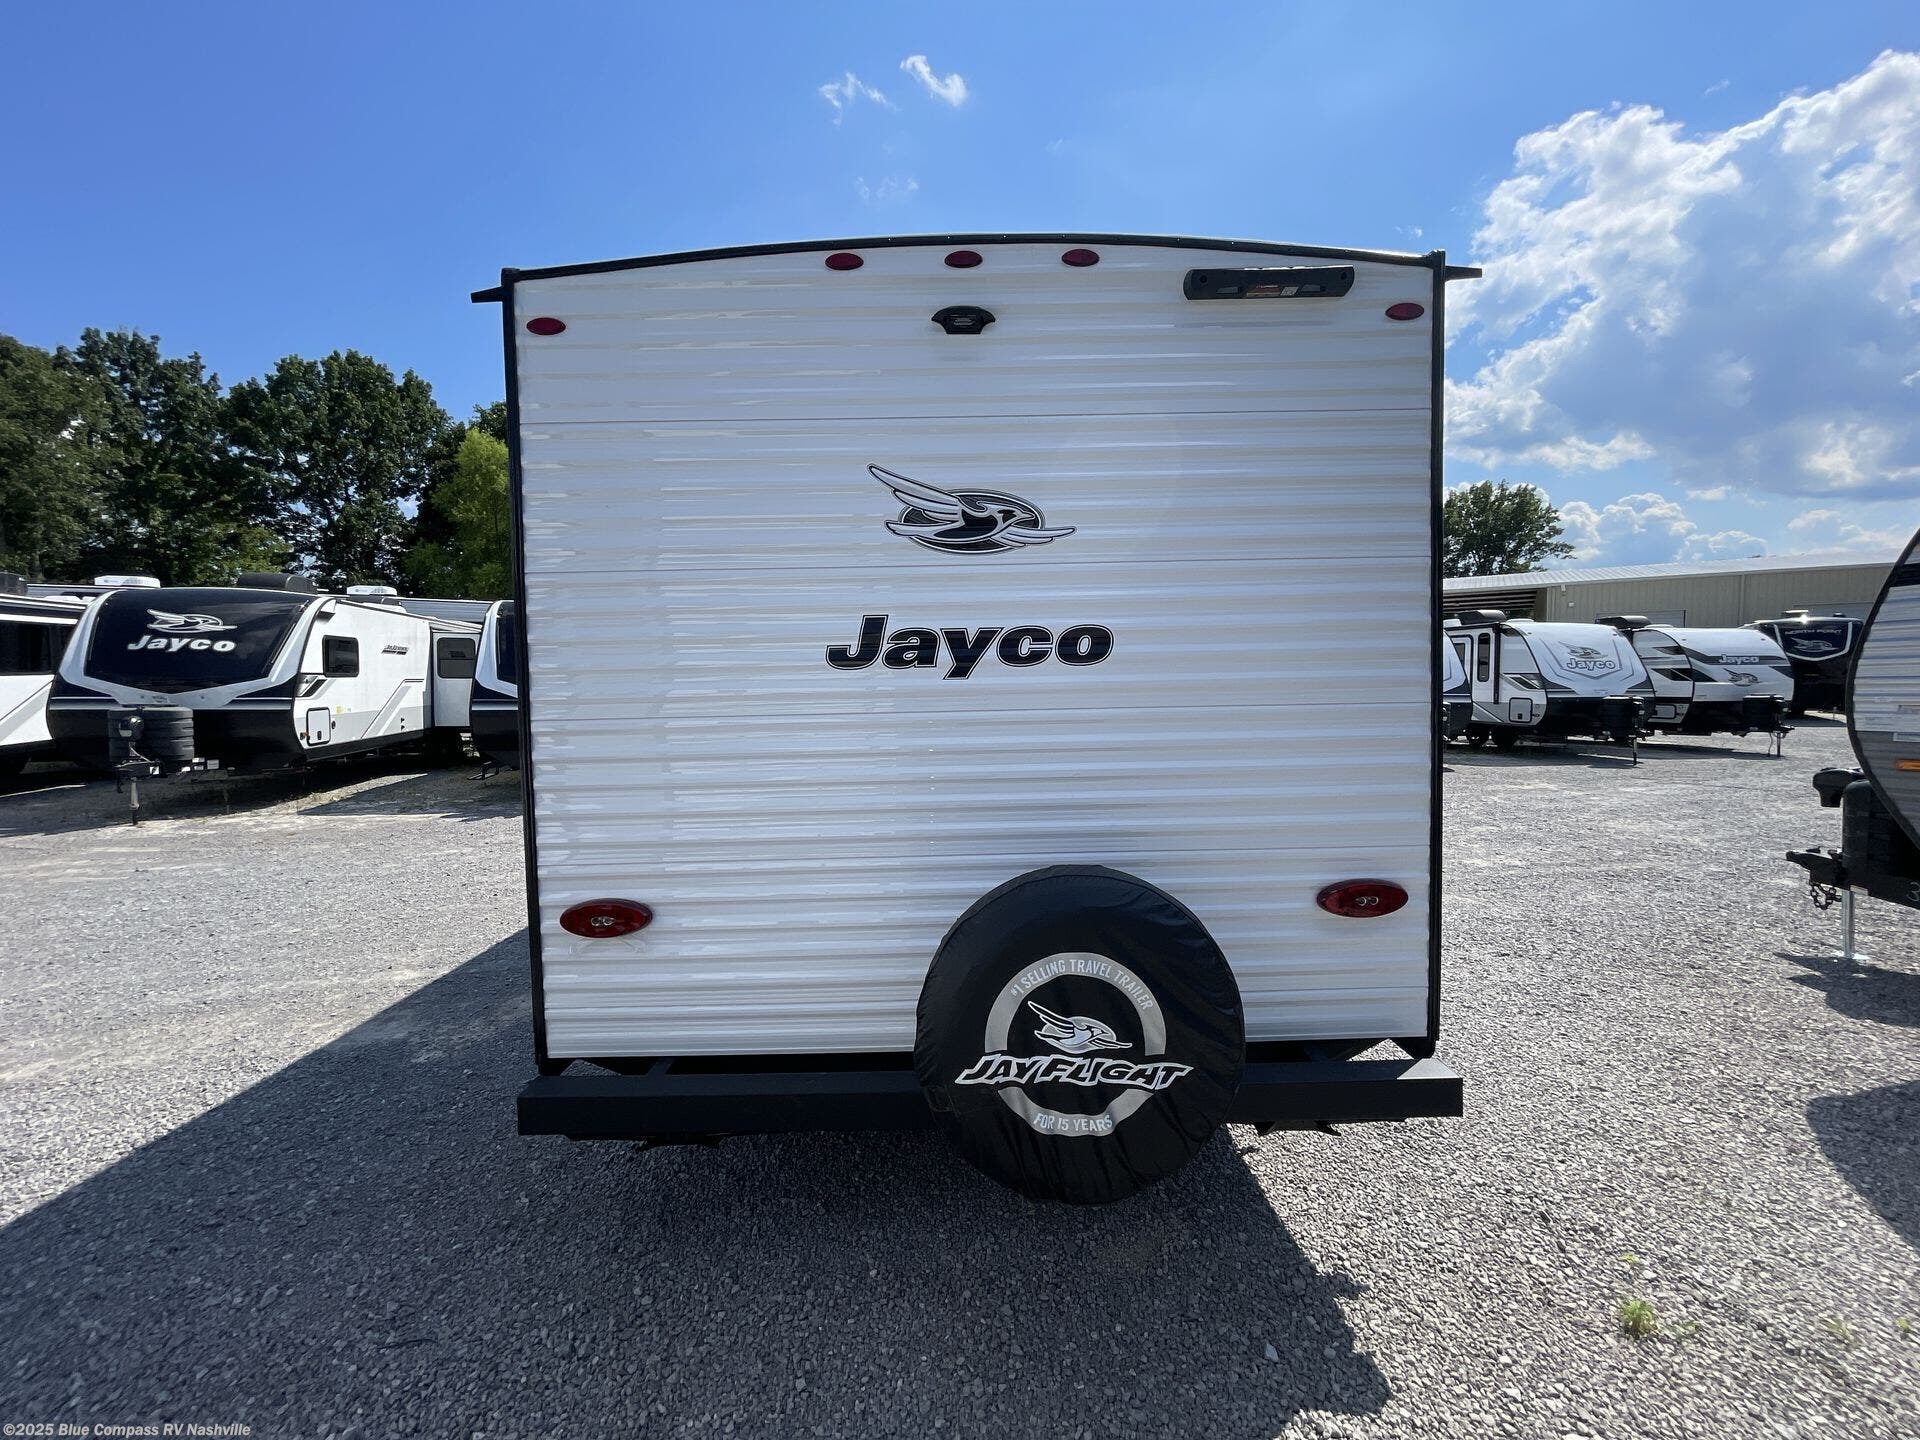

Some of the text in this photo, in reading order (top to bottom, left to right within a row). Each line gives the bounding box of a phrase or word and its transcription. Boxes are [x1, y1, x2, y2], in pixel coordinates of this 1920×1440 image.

[127, 634, 237, 652] Jayco
[825, 614, 1115, 681] Jayco
[1566, 657, 1616, 671] Jayco
[1718, 653, 1760, 665] Jayco
[1010, 959, 1154, 1011] #1 SELLING TRAVEL TRAILER
[1033, 1112, 1113, 1132] FOR 15 YEARS
